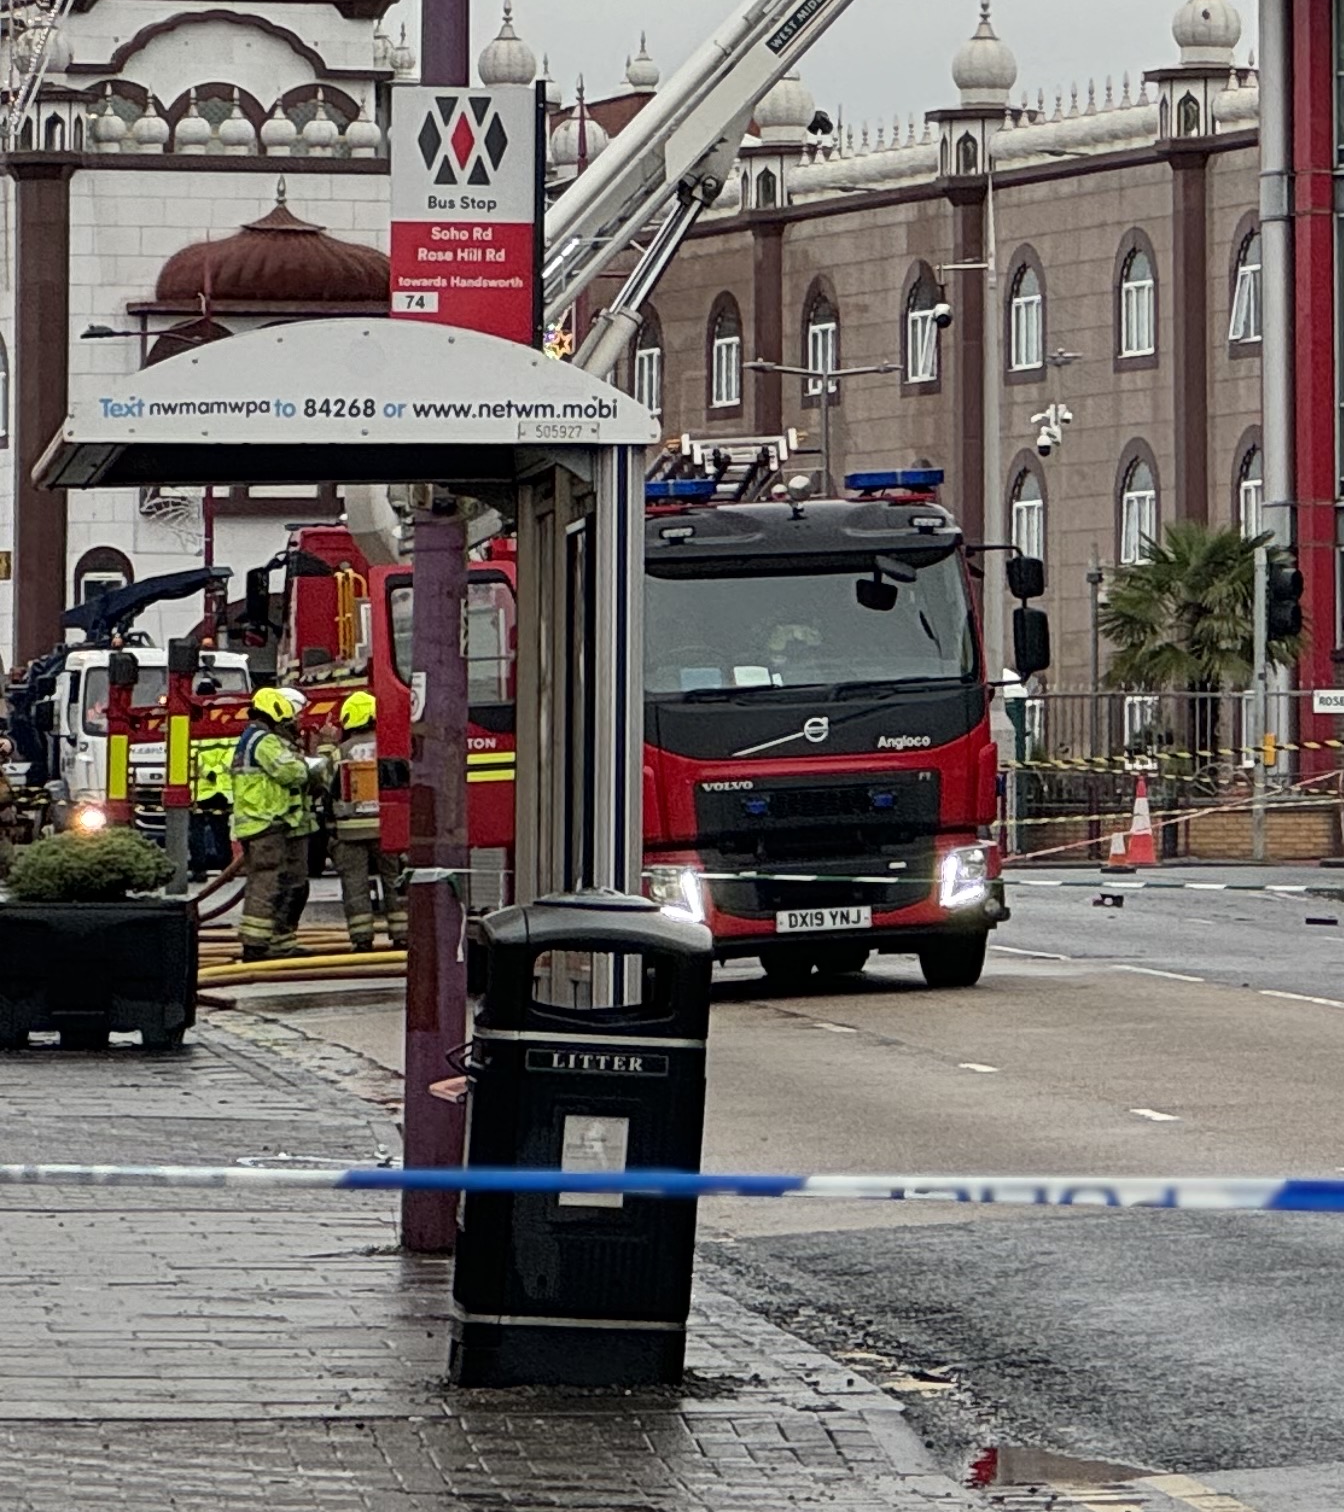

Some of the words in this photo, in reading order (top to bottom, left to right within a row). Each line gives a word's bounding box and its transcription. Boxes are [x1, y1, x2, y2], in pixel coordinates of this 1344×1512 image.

[770, 21, 799, 50] WEST
[427, 195, 456, 210] Bus
[460, 195, 497, 212] Stop
[431, 226, 469, 241] Soho
[472, 226, 493, 241] Rd
[417, 247, 453, 262] Rose
[456, 247, 482, 262] Hill
[485, 247, 506, 262] Rd
[398, 275, 447, 288] towards
[450, 275, 524, 289] Handsworth
[405, 295, 426, 309] 74
[99, 397, 145, 418] Text
[149, 399, 271, 419] nwmamwpa
[274, 398, 297, 418] to
[303, 398, 376, 419] 84268
[383, 401, 407, 418] or
[412, 398, 618, 420] www.netwm.mobi
[535, 424, 583, 439] 505927
[877, 734, 931, 750] Angloco
[702, 780, 753, 793] VOLVO
[787, 911, 825, 929] DX19
[829, 908, 862, 926] YNJ
[552, 1051, 644, 1072] LITTER
